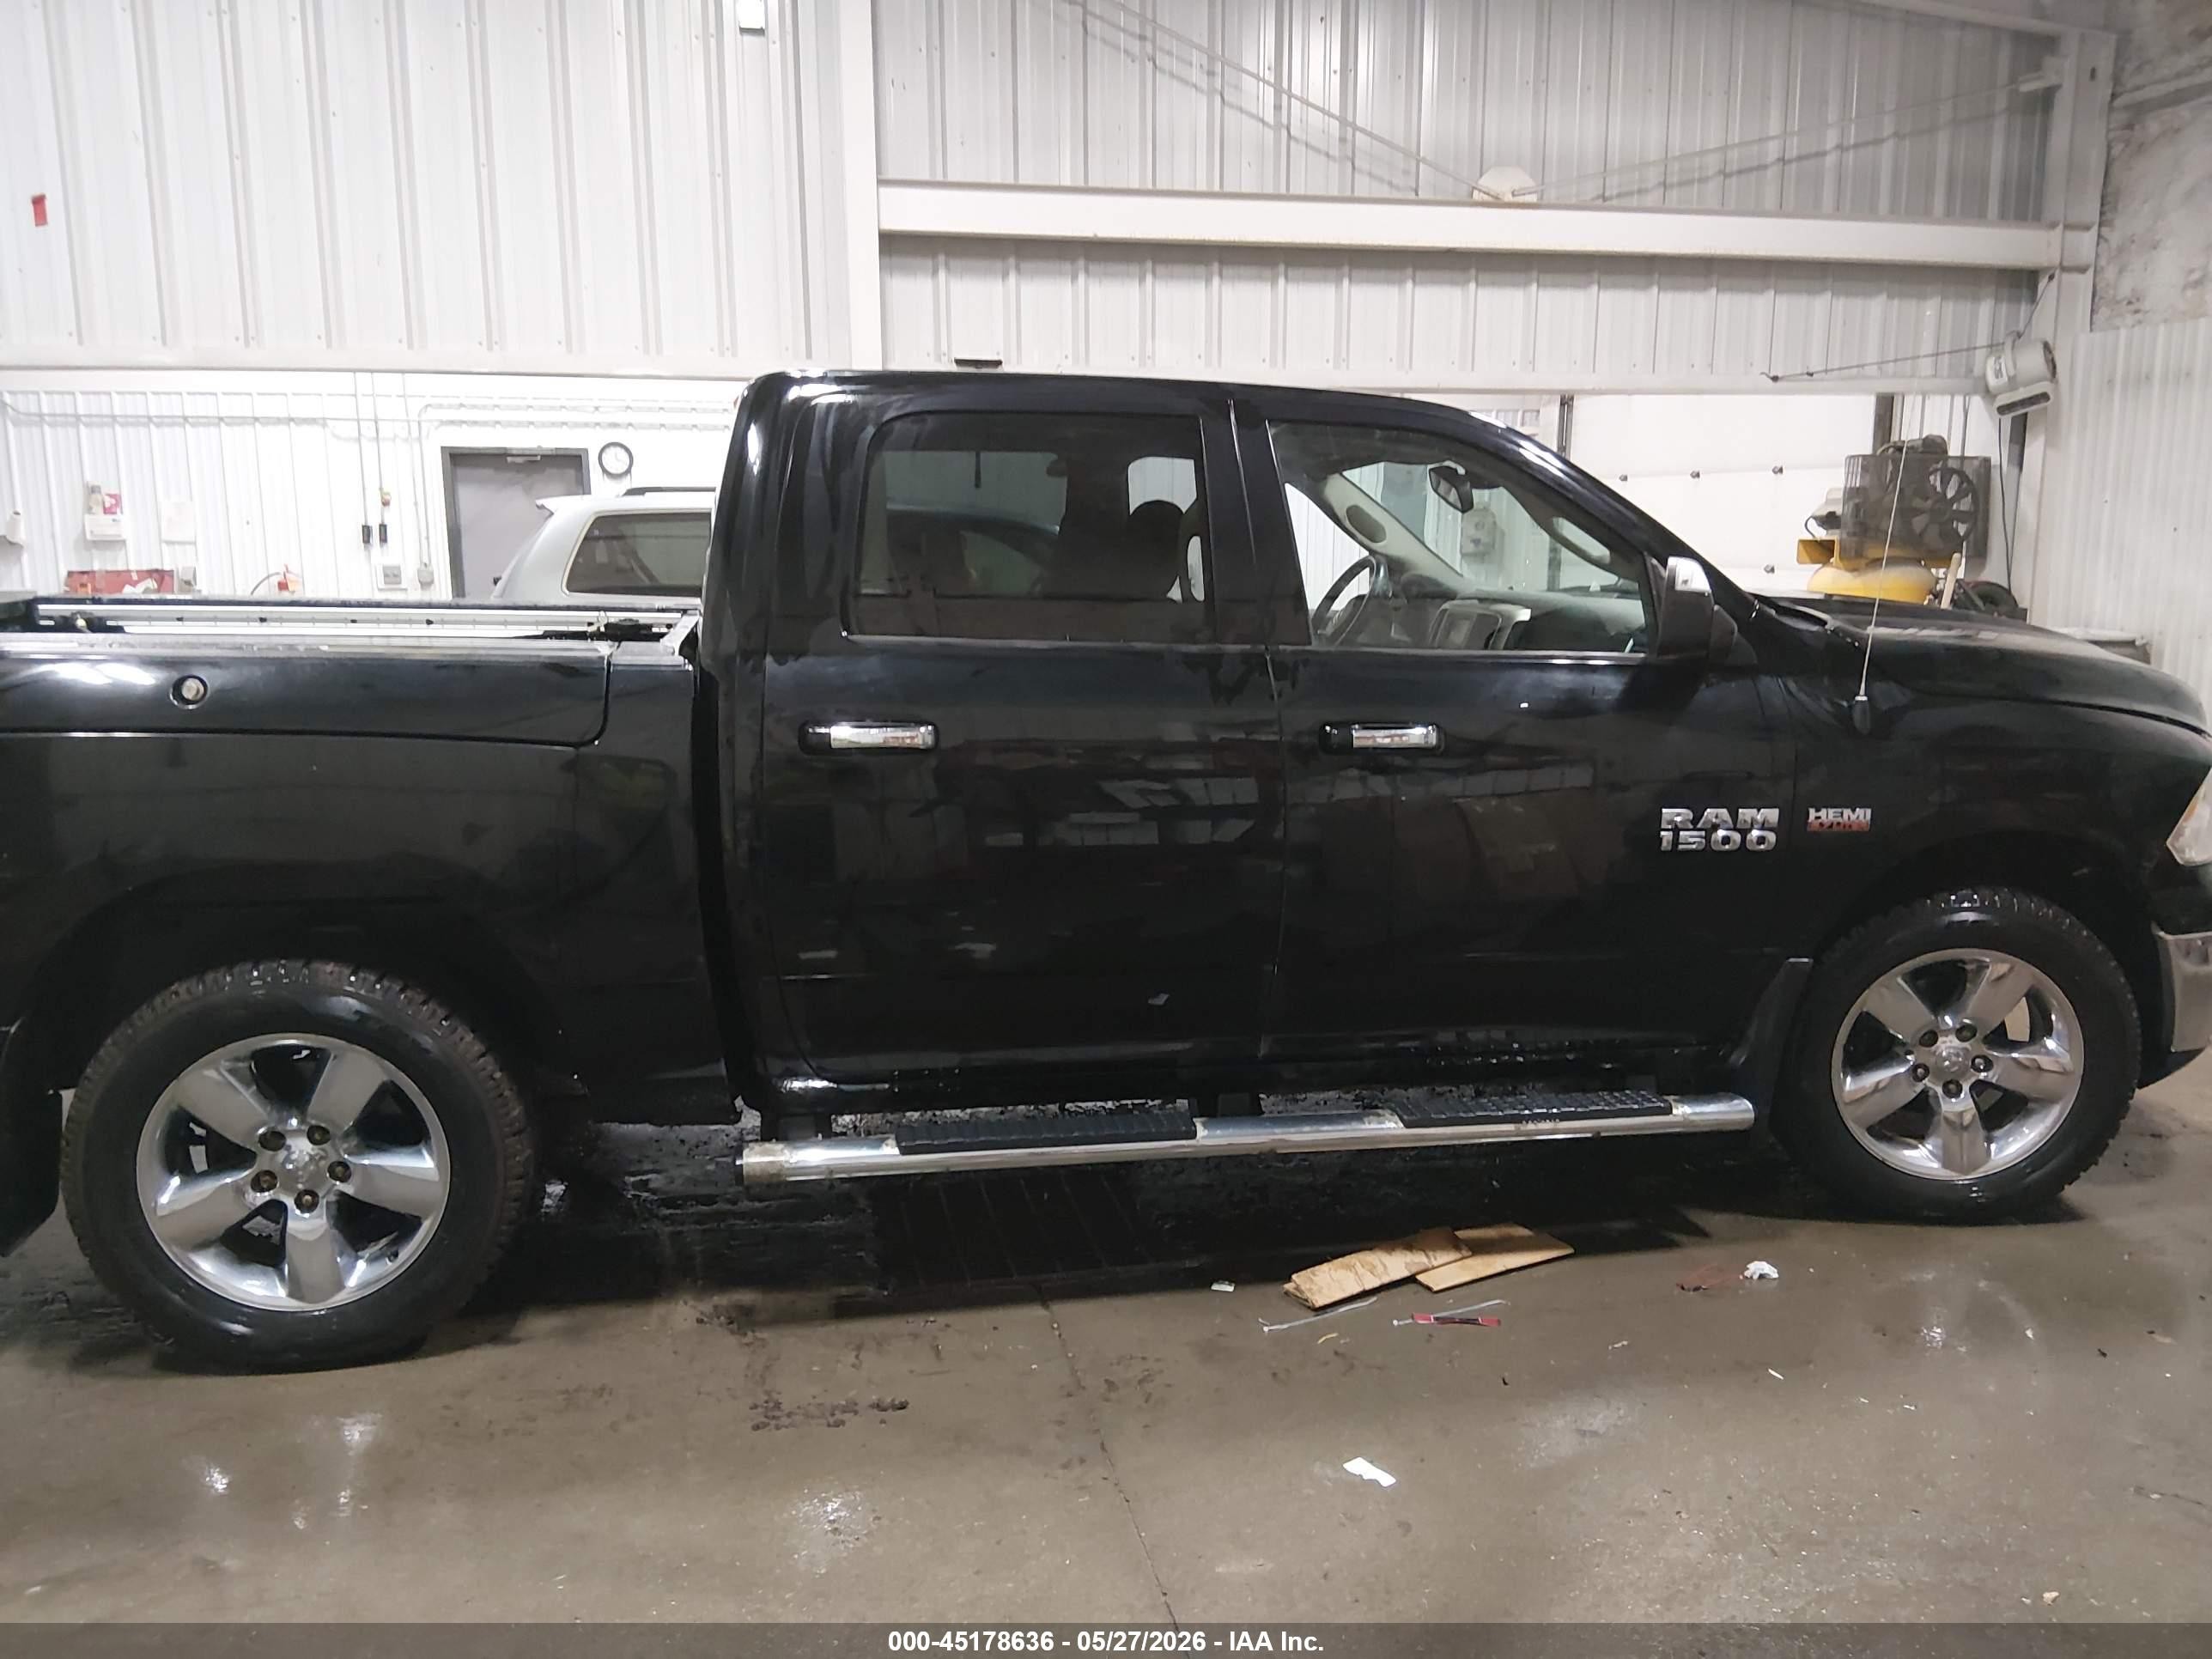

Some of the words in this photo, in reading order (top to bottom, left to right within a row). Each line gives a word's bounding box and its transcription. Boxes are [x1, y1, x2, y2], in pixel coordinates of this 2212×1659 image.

[1661, 808, 1780, 829] RAM
[1808, 807, 1872, 823] HEMI
[1660, 830, 1777, 851] 1500
